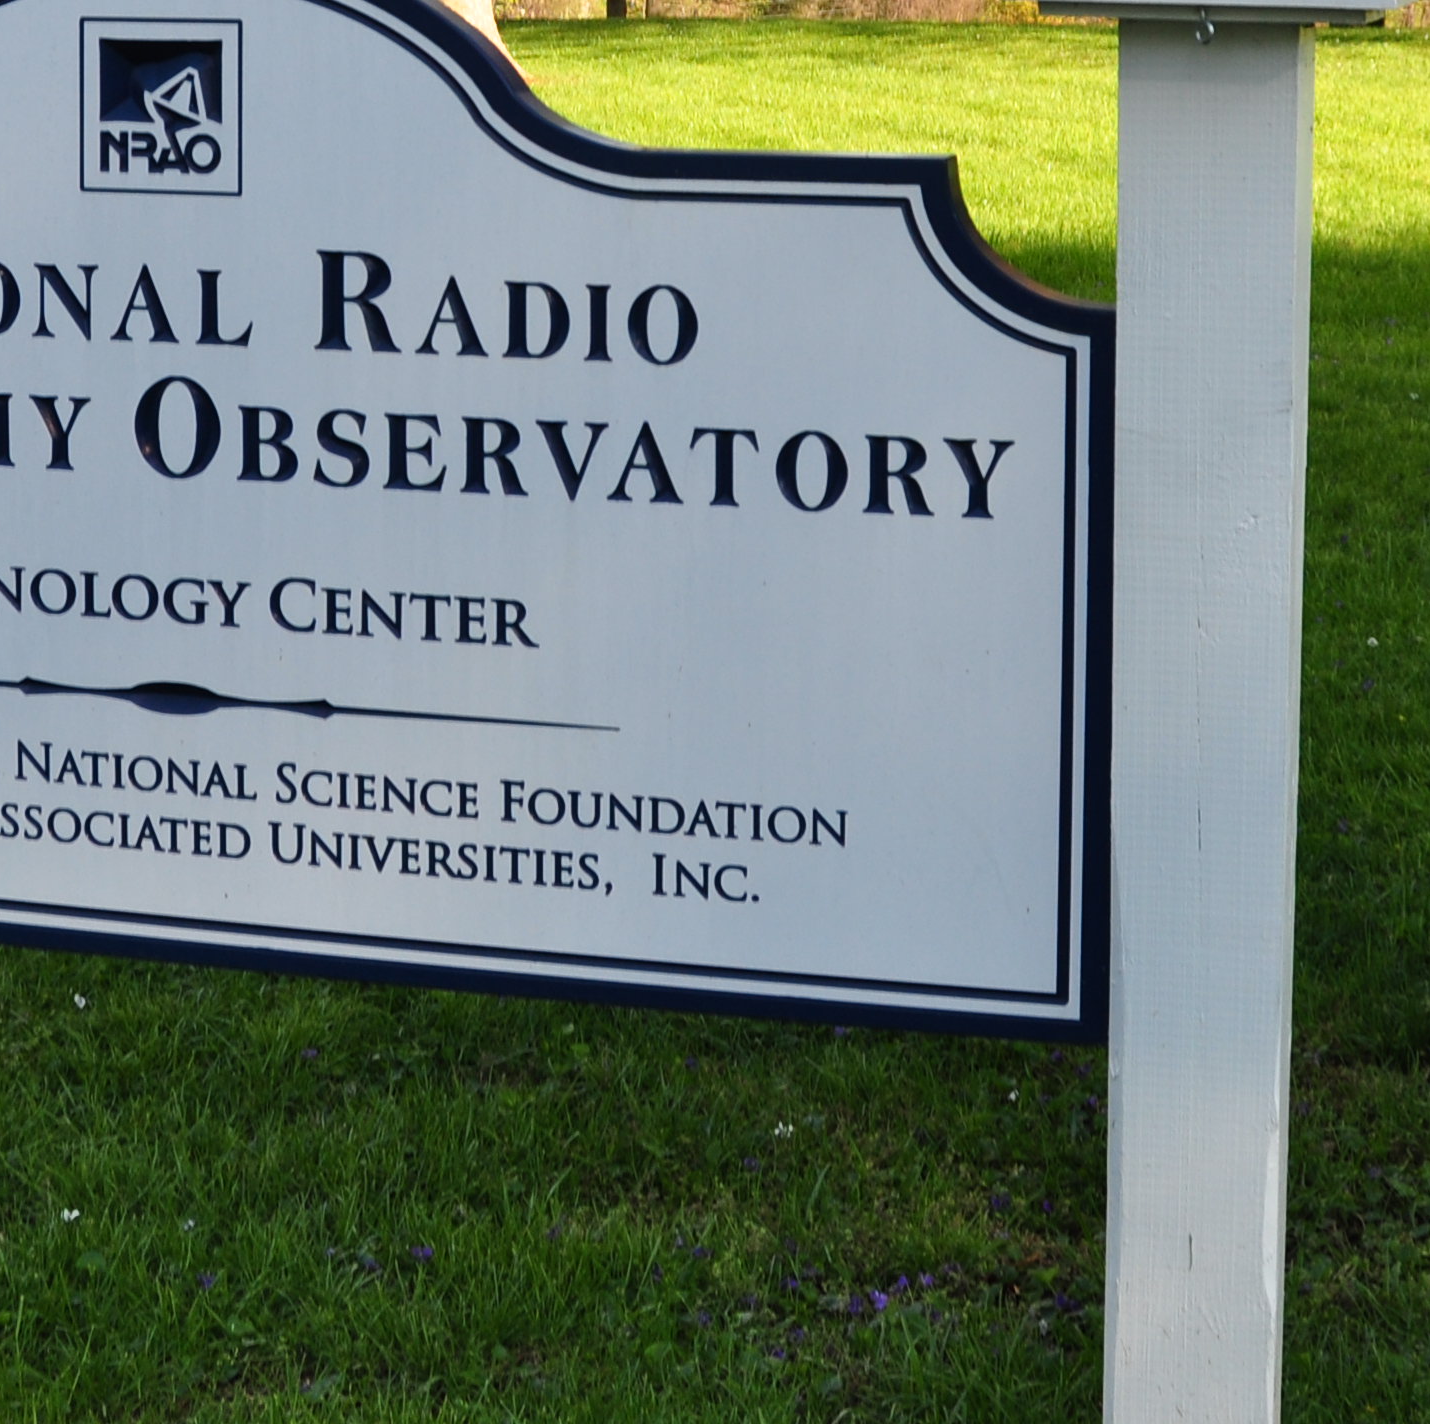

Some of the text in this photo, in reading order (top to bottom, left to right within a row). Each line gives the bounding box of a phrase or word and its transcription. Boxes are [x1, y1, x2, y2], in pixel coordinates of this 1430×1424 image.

[97, 126, 224, 177] NRAO
[313, 248, 700, 367] RADIO
[133, 374, 1016, 521] OBSERVATORY
[268, 576, 541, 649] CENTER
[14, 738, 259, 802] NATIONAL
[274, 761, 480, 820] SCIENCE
[499, 778, 849, 849] FOUNDATION
[267, 820, 614, 897] UNIVERSITIES,
[651, 851, 761, 904] INC.
